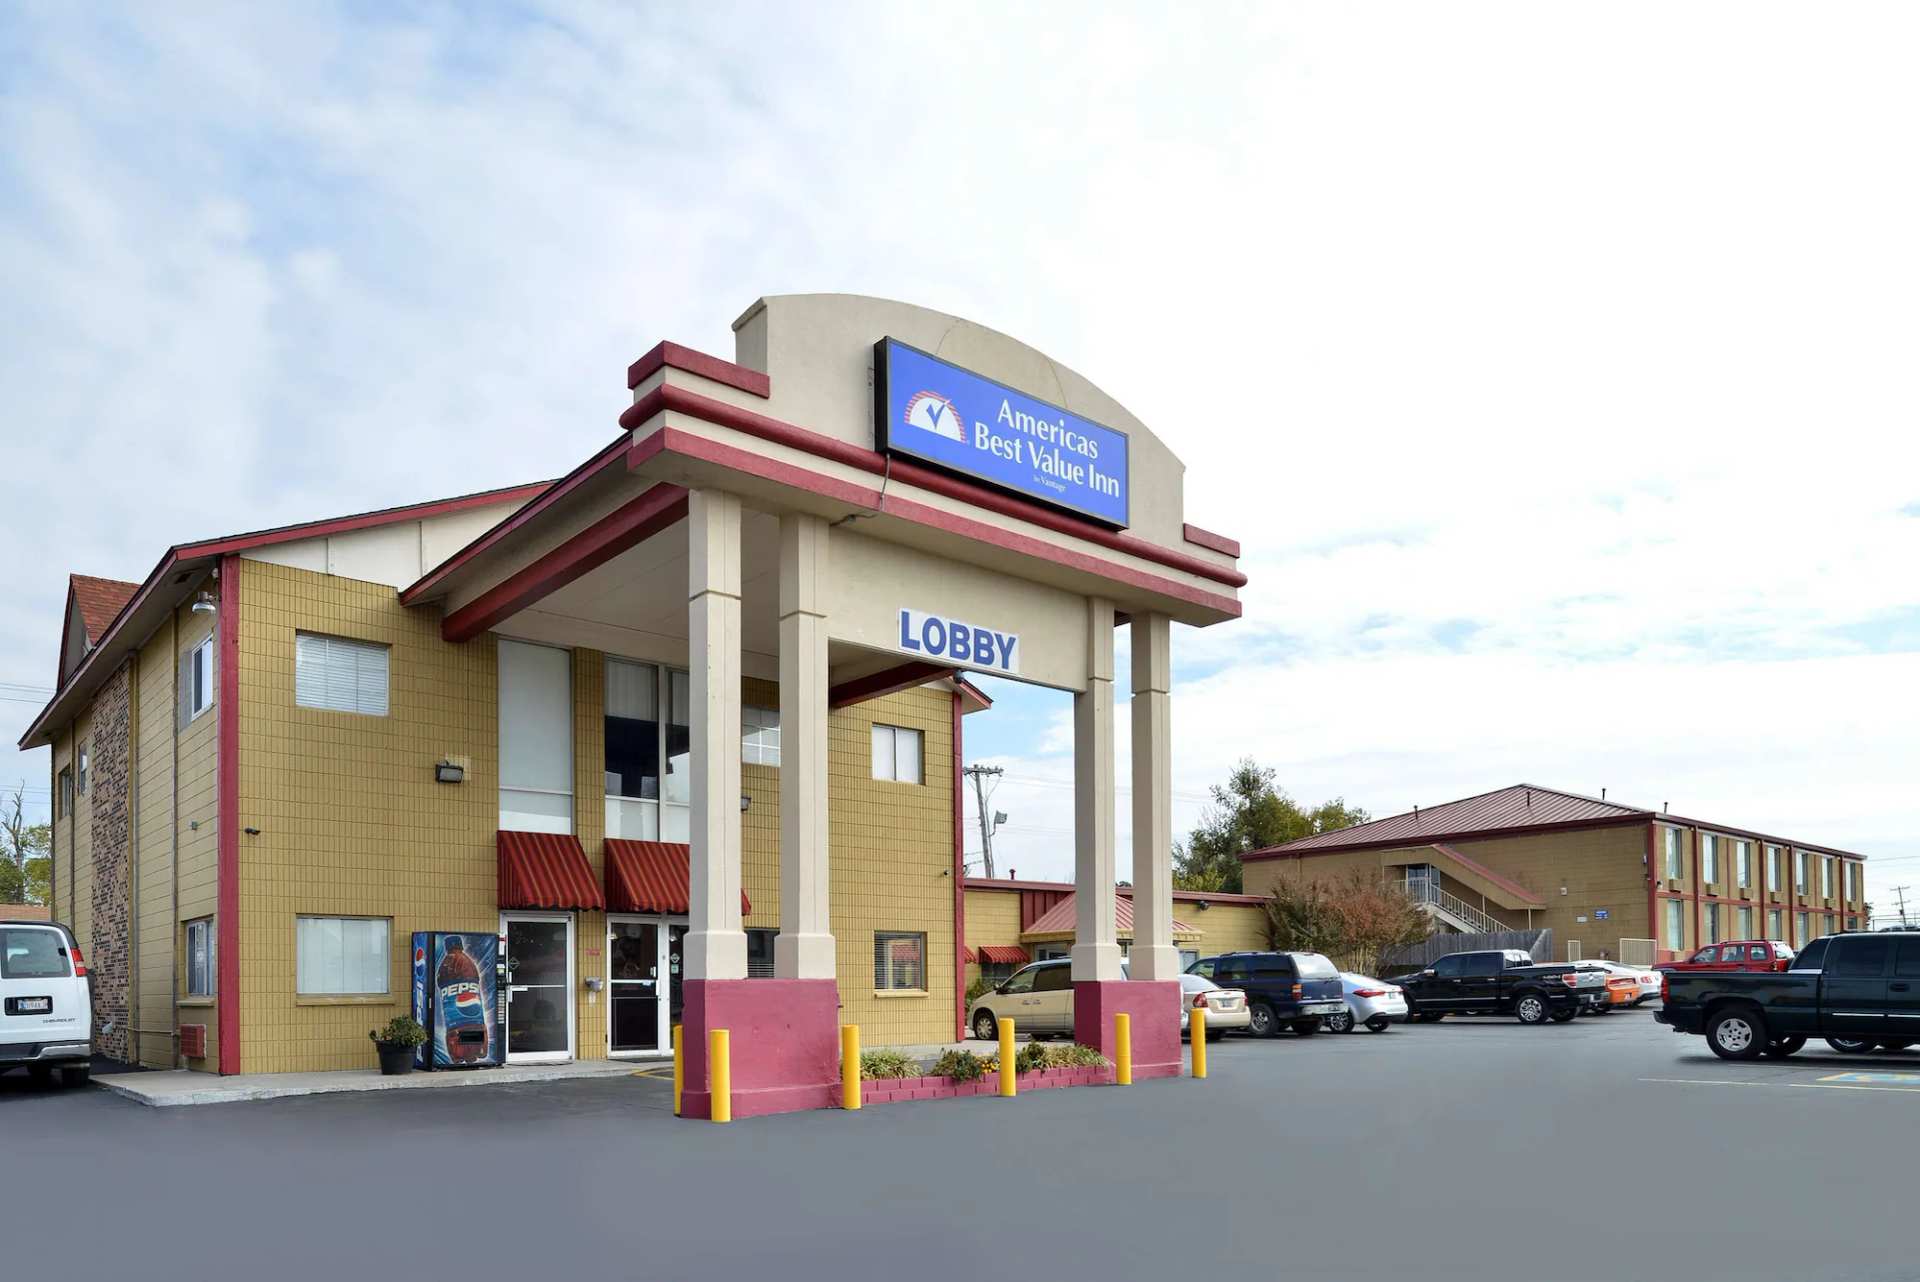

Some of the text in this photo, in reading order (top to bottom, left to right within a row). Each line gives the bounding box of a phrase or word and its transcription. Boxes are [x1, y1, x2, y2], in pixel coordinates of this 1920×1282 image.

[998, 399, 1098, 459] Americas
[975, 421, 1023, 464] Best
[1027, 440, 1085, 485] Value
[1089, 463, 1120, 498] Inn
[901, 610, 1017, 670] LOBBY
